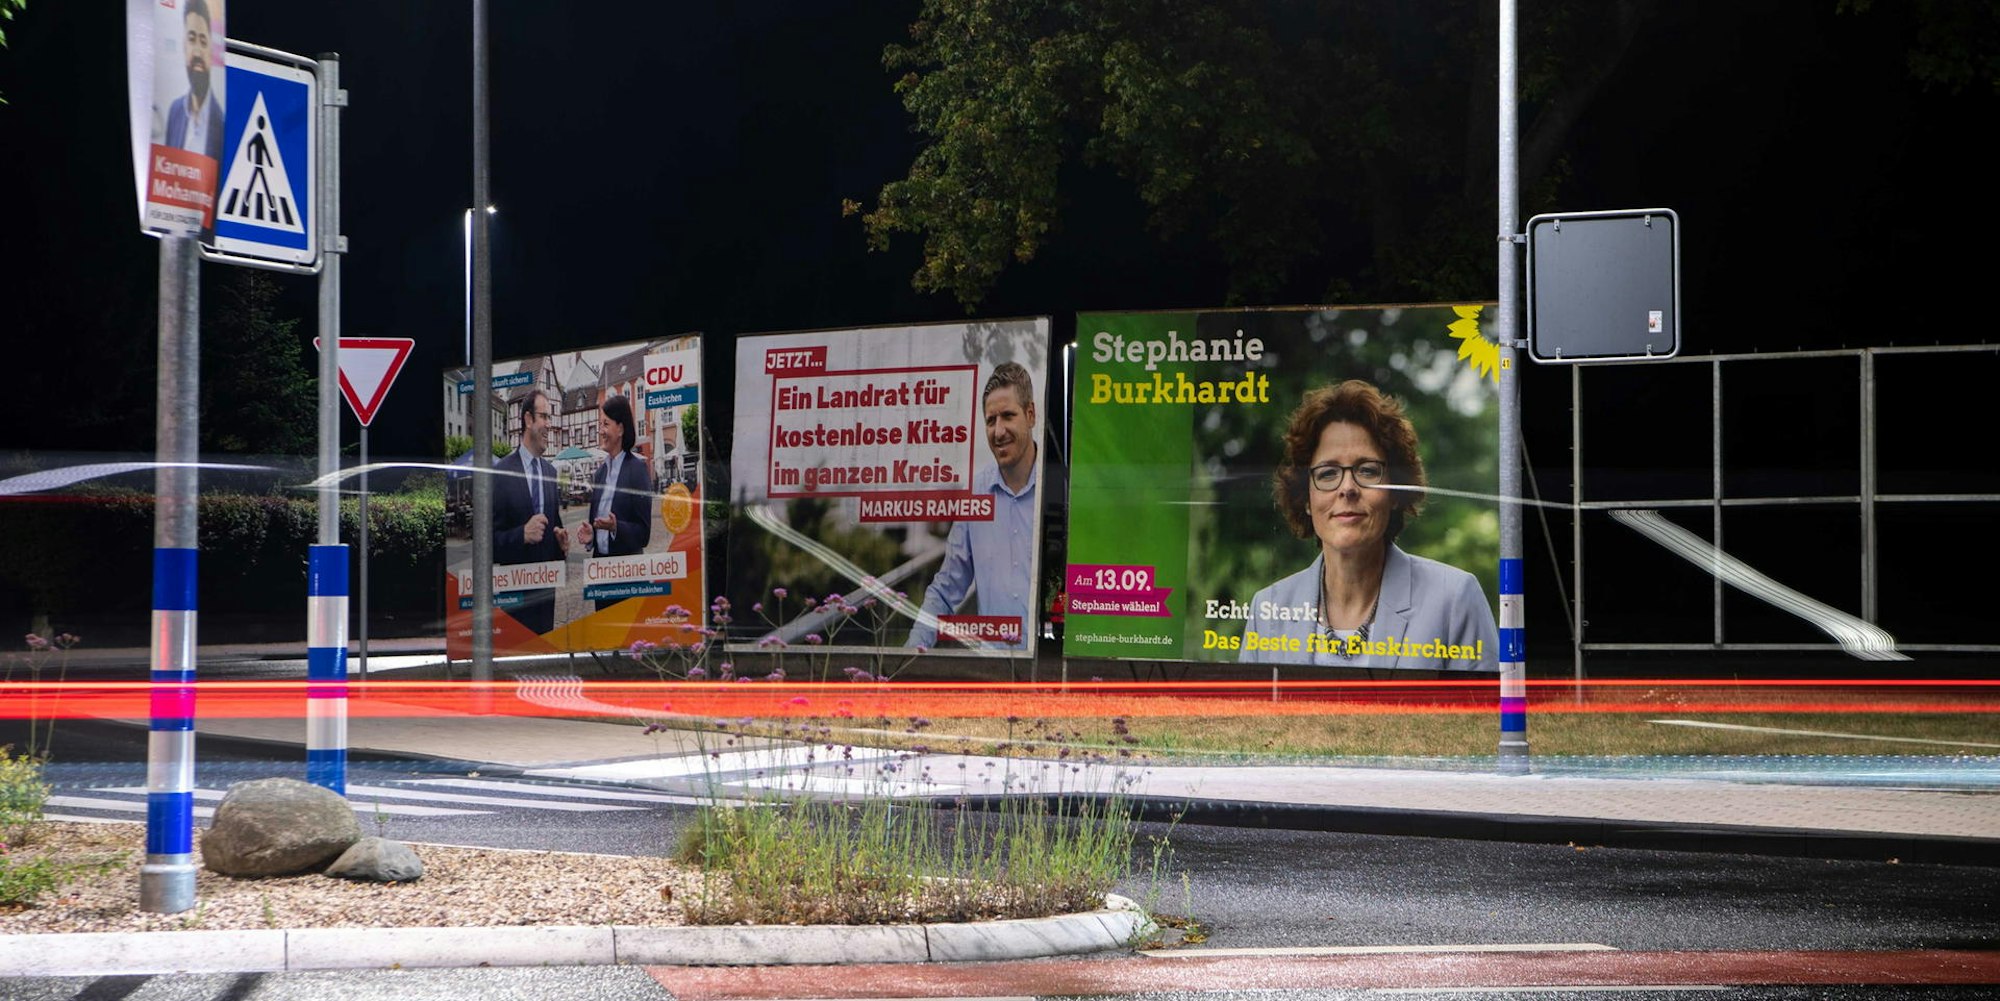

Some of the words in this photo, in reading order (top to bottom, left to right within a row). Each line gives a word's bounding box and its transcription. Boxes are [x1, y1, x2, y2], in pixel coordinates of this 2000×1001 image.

[154, 155, 202, 179] Karwan
[766, 351, 823, 369] JETZT...
[1092, 329, 1264, 371] Stephanie
[646, 364, 683, 386] CDU
[1502, 358, 1510, 369] 41
[778, 386, 812, 410] Ein
[817, 382, 909, 409] Landrat
[914, 379, 950, 405] für
[1090, 371, 1270, 404] Burkhardt
[648, 394, 682, 406] Euskirchen
[776, 422, 902, 448] kostenlose
[907, 419, 968, 444] Kitas
[774, 462, 800, 485] im
[804, 465, 887, 492] ganzen
[892, 457, 960, 483] Kreis.
[861, 500, 923, 517] MARKUS
[926, 499, 992, 516] RAMERS
[588, 560, 646, 580] Christiane
[650, 555, 679, 576] Loeb
[462, 573, 509, 595] Jones
[511, 565, 559, 586] Winckler
[639, 585, 664, 593] Euskirchen
[1074, 574, 1093, 587] Am
[1095, 568, 1151, 592] 13.09.
[1072, 599, 1120, 613] Stephanie
[1121, 601, 1160, 613] wählen!
[1205, 599, 1254, 620] Echt.
[1259, 600, 1324, 623] Stark.
[939, 621, 1019, 637] ramers.eu
[1075, 632, 1173, 645] stephanie-burkhardt.de
[1203, 629, 1241, 650] Das
[1246, 631, 1301, 652] Beste
[1306, 632, 1342, 655] für
[1346, 634, 1484, 661] Euskirchen!
